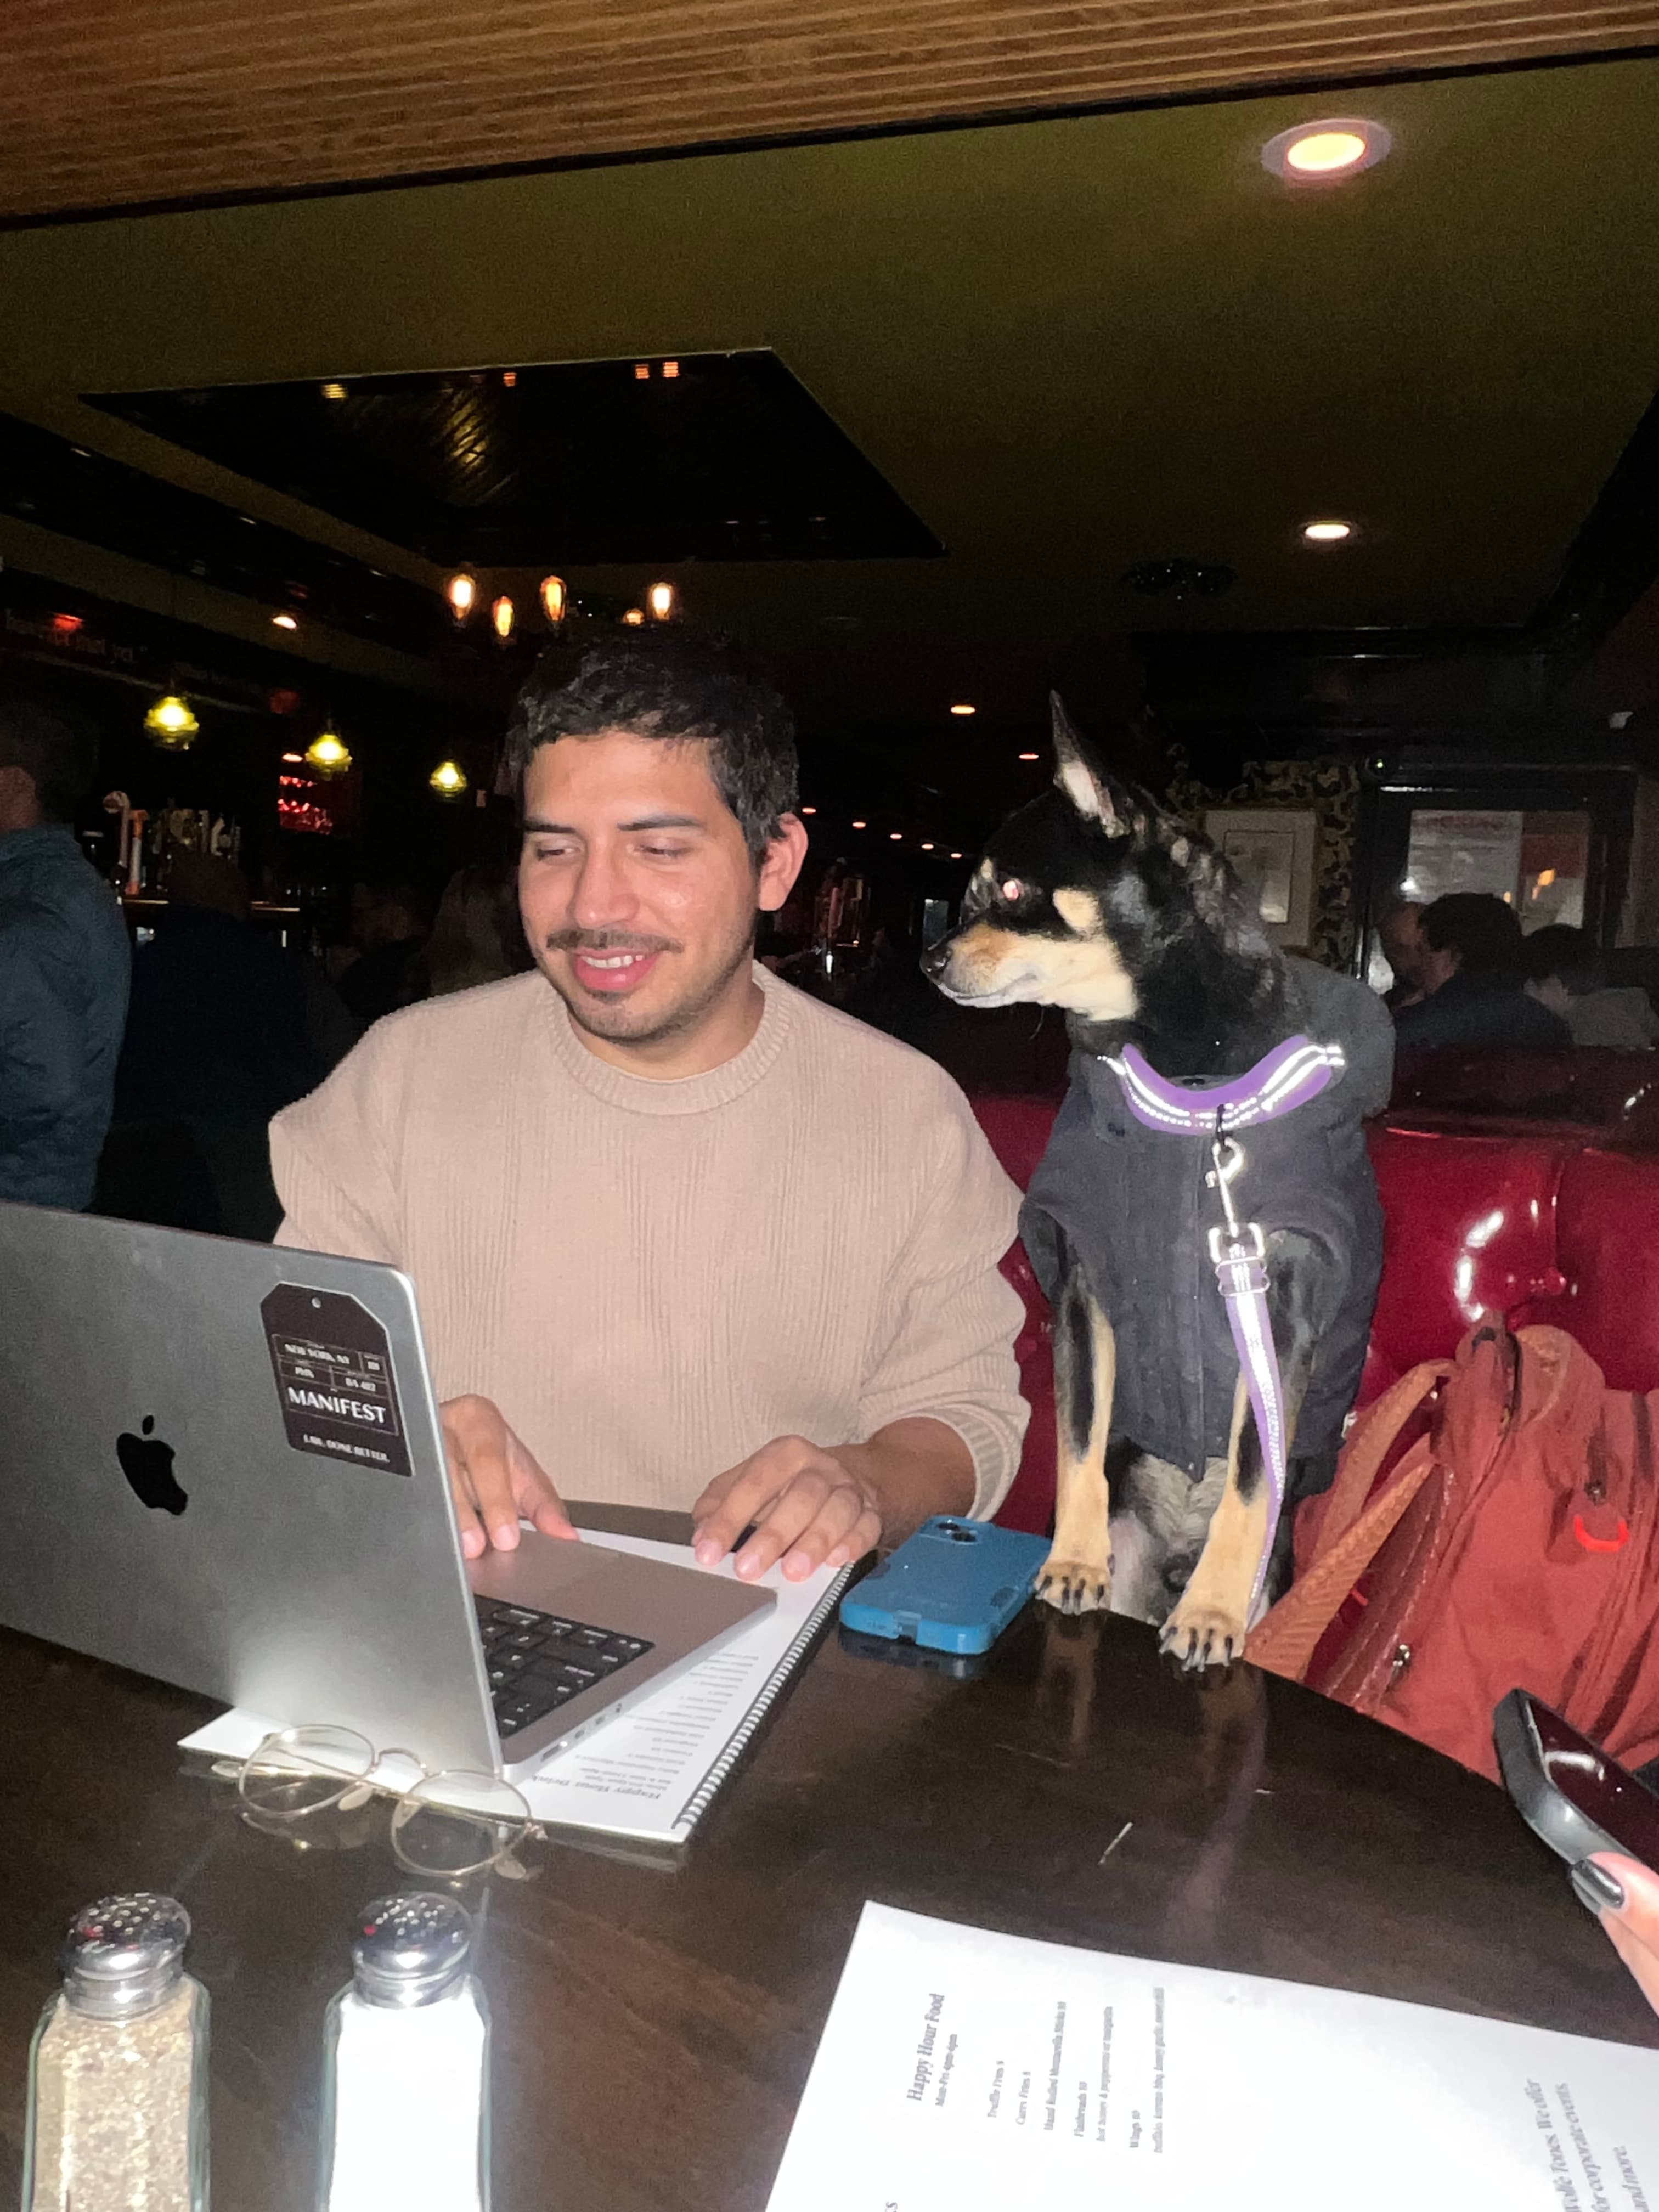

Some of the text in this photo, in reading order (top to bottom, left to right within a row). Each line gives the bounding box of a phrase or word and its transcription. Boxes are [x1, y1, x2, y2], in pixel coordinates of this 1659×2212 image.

[287, 1386, 386, 1423] MANIFEST
[532, 1775, 570, 1786] Drink
[906, 1993, 945, 2100] Happy Hour Food
[992, 2068, 1004, 2087] Fries
[1018, 2078, 1030, 2098] Fries
[1524, 2078, 1548, 2109] offer
[1555, 2083, 1579, 2124] events
[1536, 2110, 1553, 2129] We
[1567, 2123, 1602, 2191] corporate
